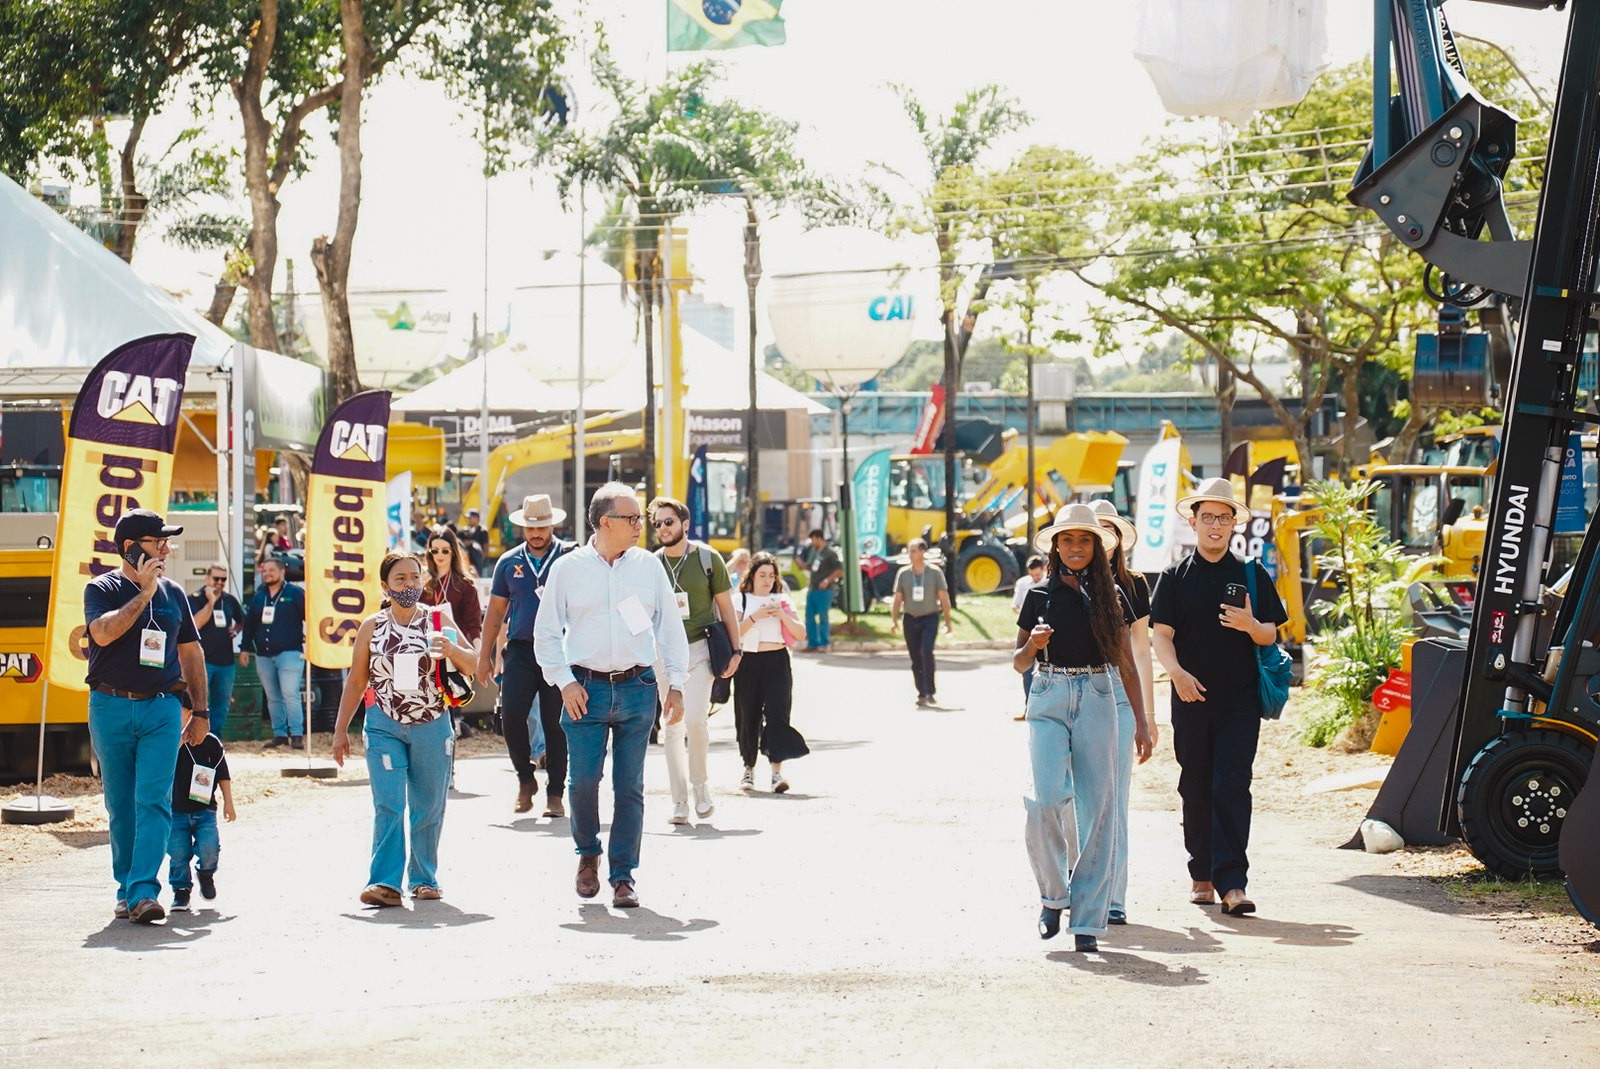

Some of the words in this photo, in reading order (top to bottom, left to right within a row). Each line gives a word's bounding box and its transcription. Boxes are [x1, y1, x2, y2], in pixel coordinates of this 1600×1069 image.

[97, 370, 179, 426] CAT
[330, 419, 386, 462] CAT
[689, 415, 742, 431] Mason
[690, 433, 742, 446] quipment
[68, 450, 158, 661] treq
[1493, 484, 1530, 595] HYUNDAI
[318, 483, 373, 647] Sotreq
[0, 653, 31, 677] CAT
